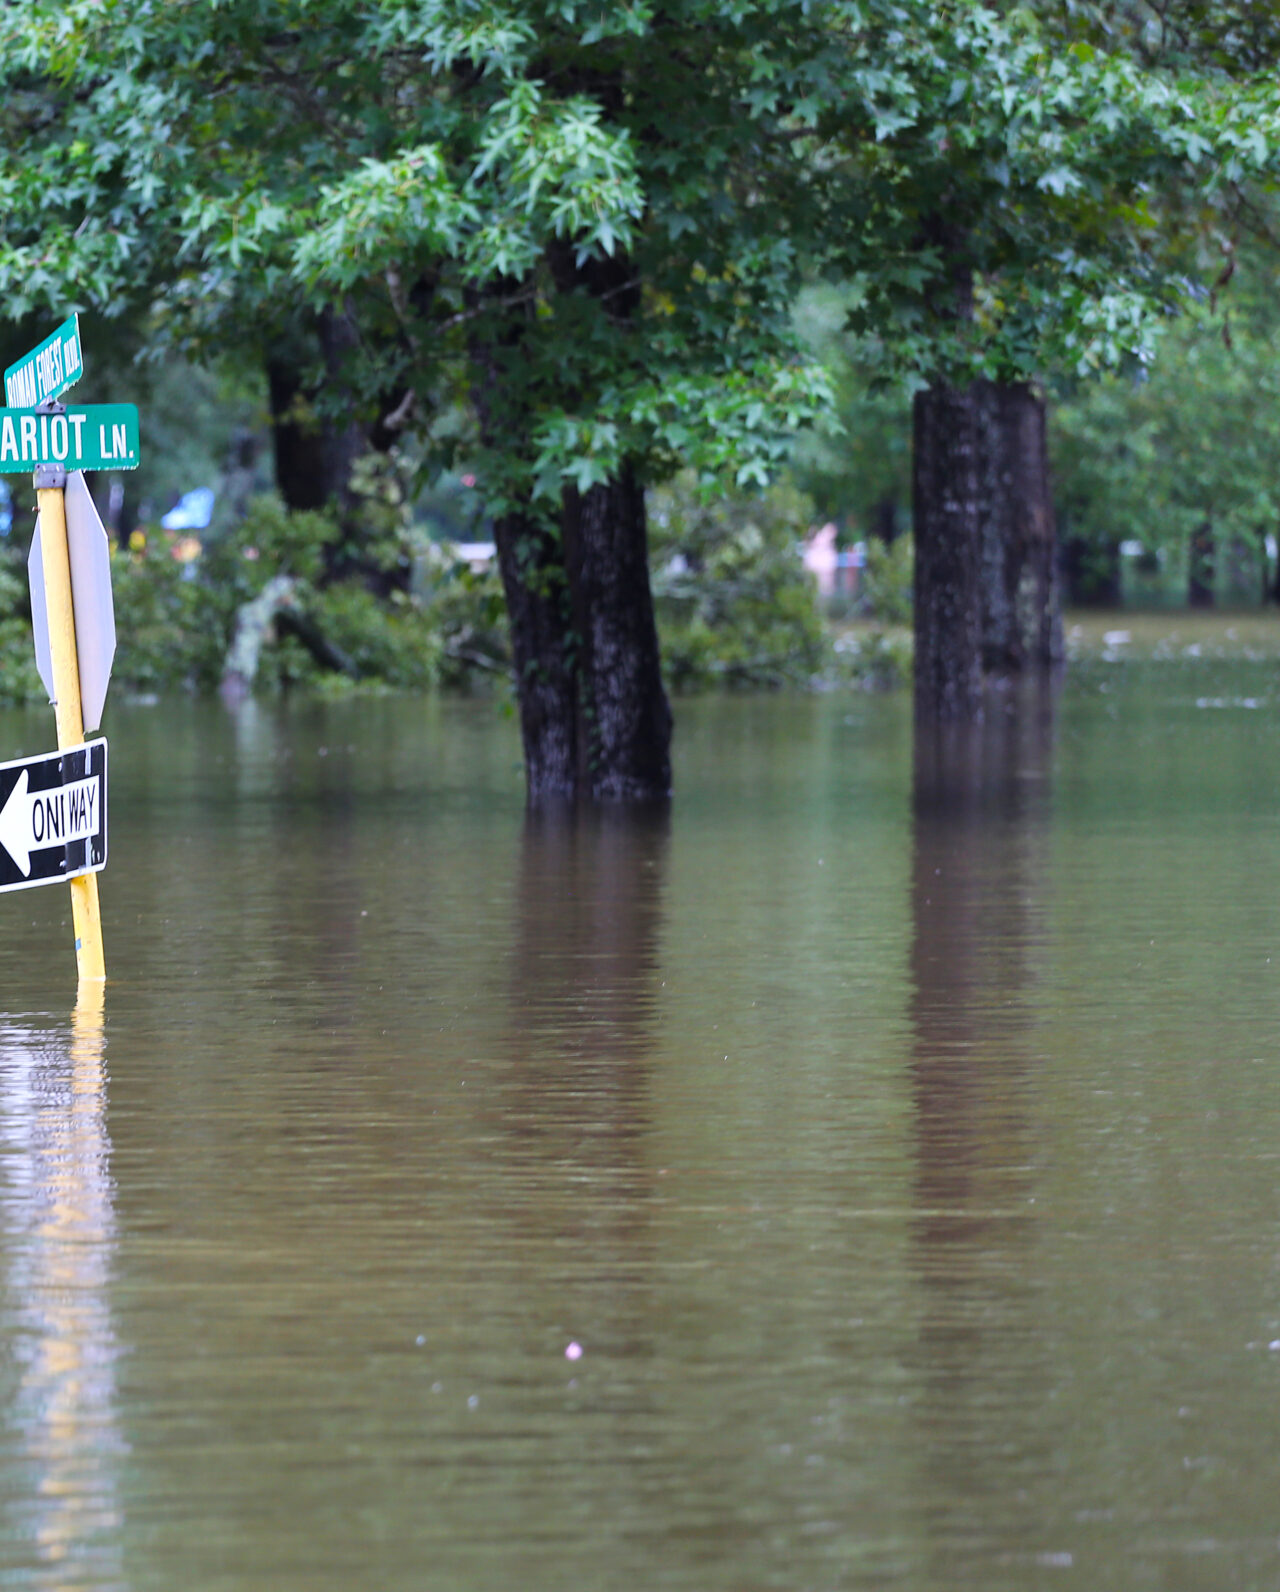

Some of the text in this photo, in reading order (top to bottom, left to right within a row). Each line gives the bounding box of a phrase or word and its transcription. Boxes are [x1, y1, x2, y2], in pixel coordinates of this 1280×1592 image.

[6, 359, 37, 408] ROMAN
[35, 335, 64, 401] FOREST
[99, 424, 134, 459] LN.
[68, 783, 96, 834] WAY
